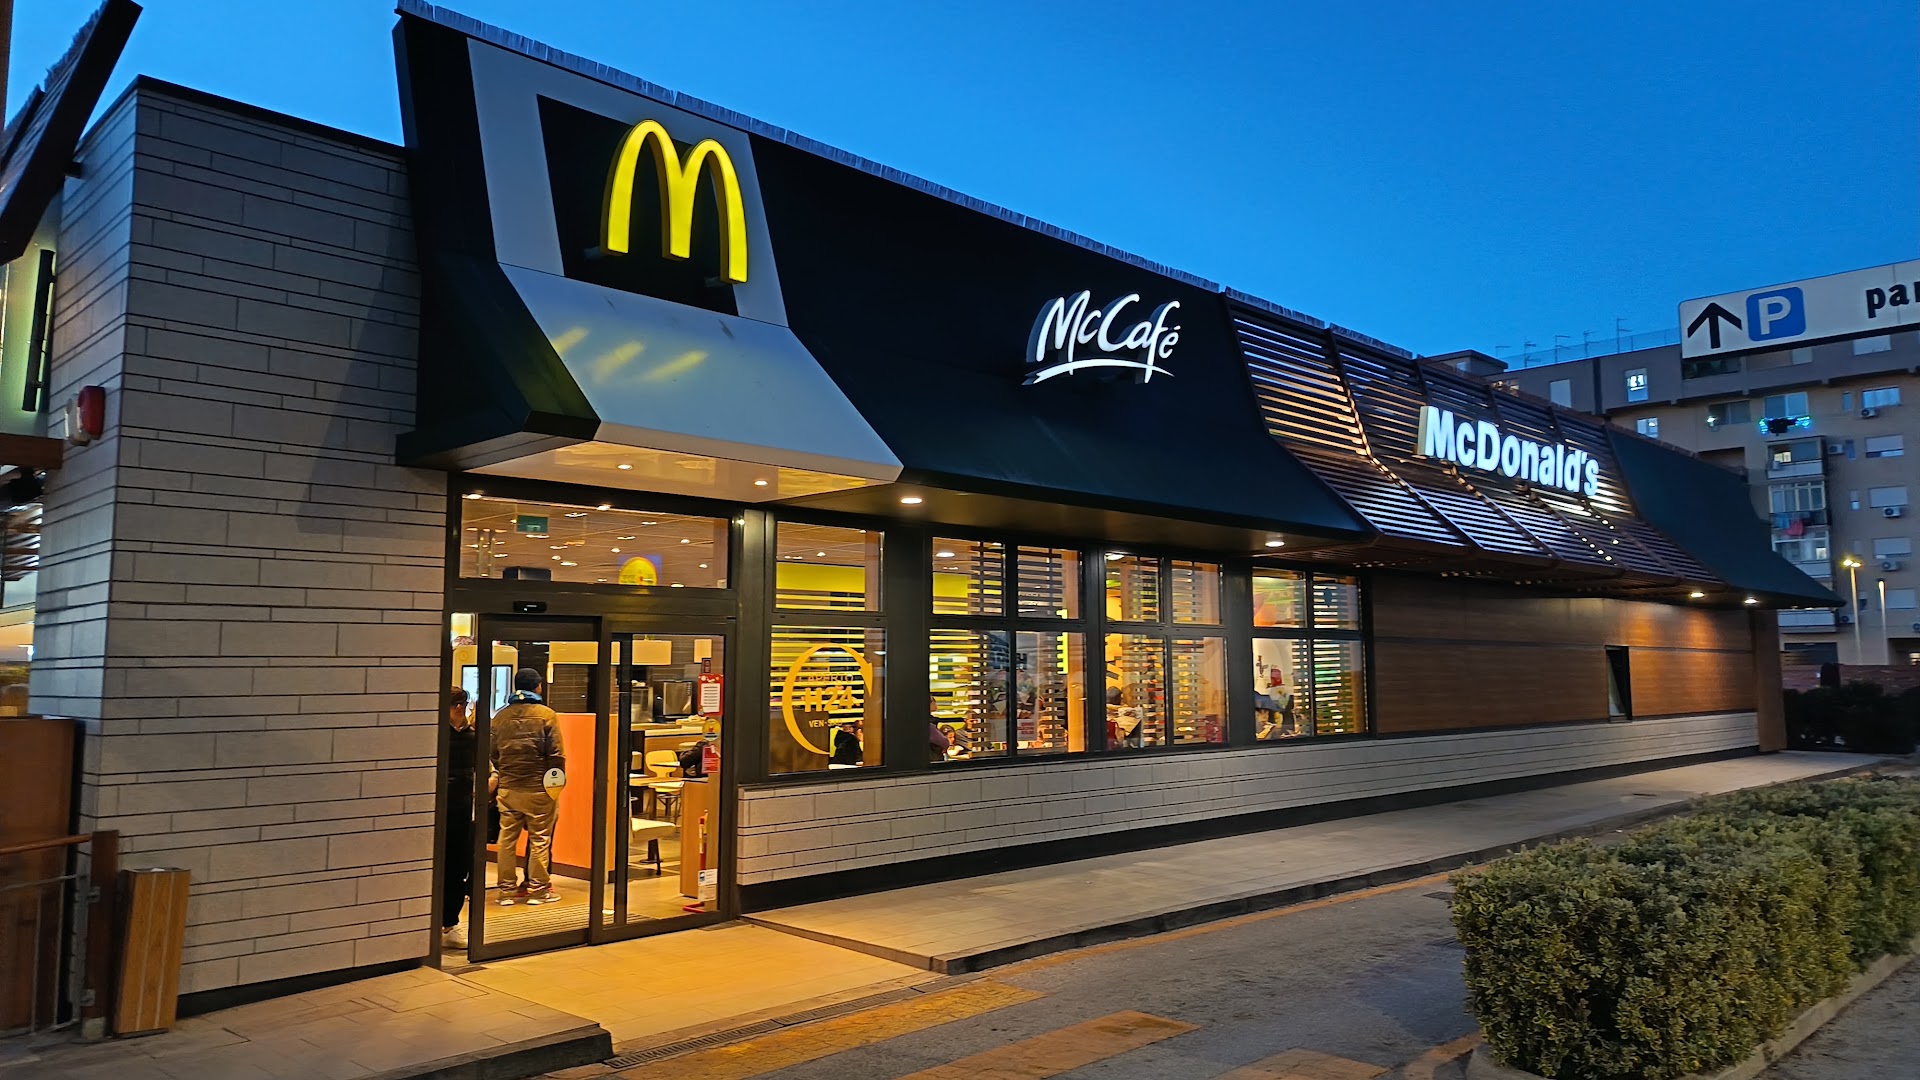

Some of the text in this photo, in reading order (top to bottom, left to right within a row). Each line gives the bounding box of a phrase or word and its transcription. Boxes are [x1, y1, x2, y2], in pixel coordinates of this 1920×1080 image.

[1758, 296, 1791, 335] P
[1033, 290, 1181, 384] McCafé
[1420, 406, 1600, 496] McDonald's
[808, 672, 854, 683] APERTO
[804, 685, 854, 713] H24
